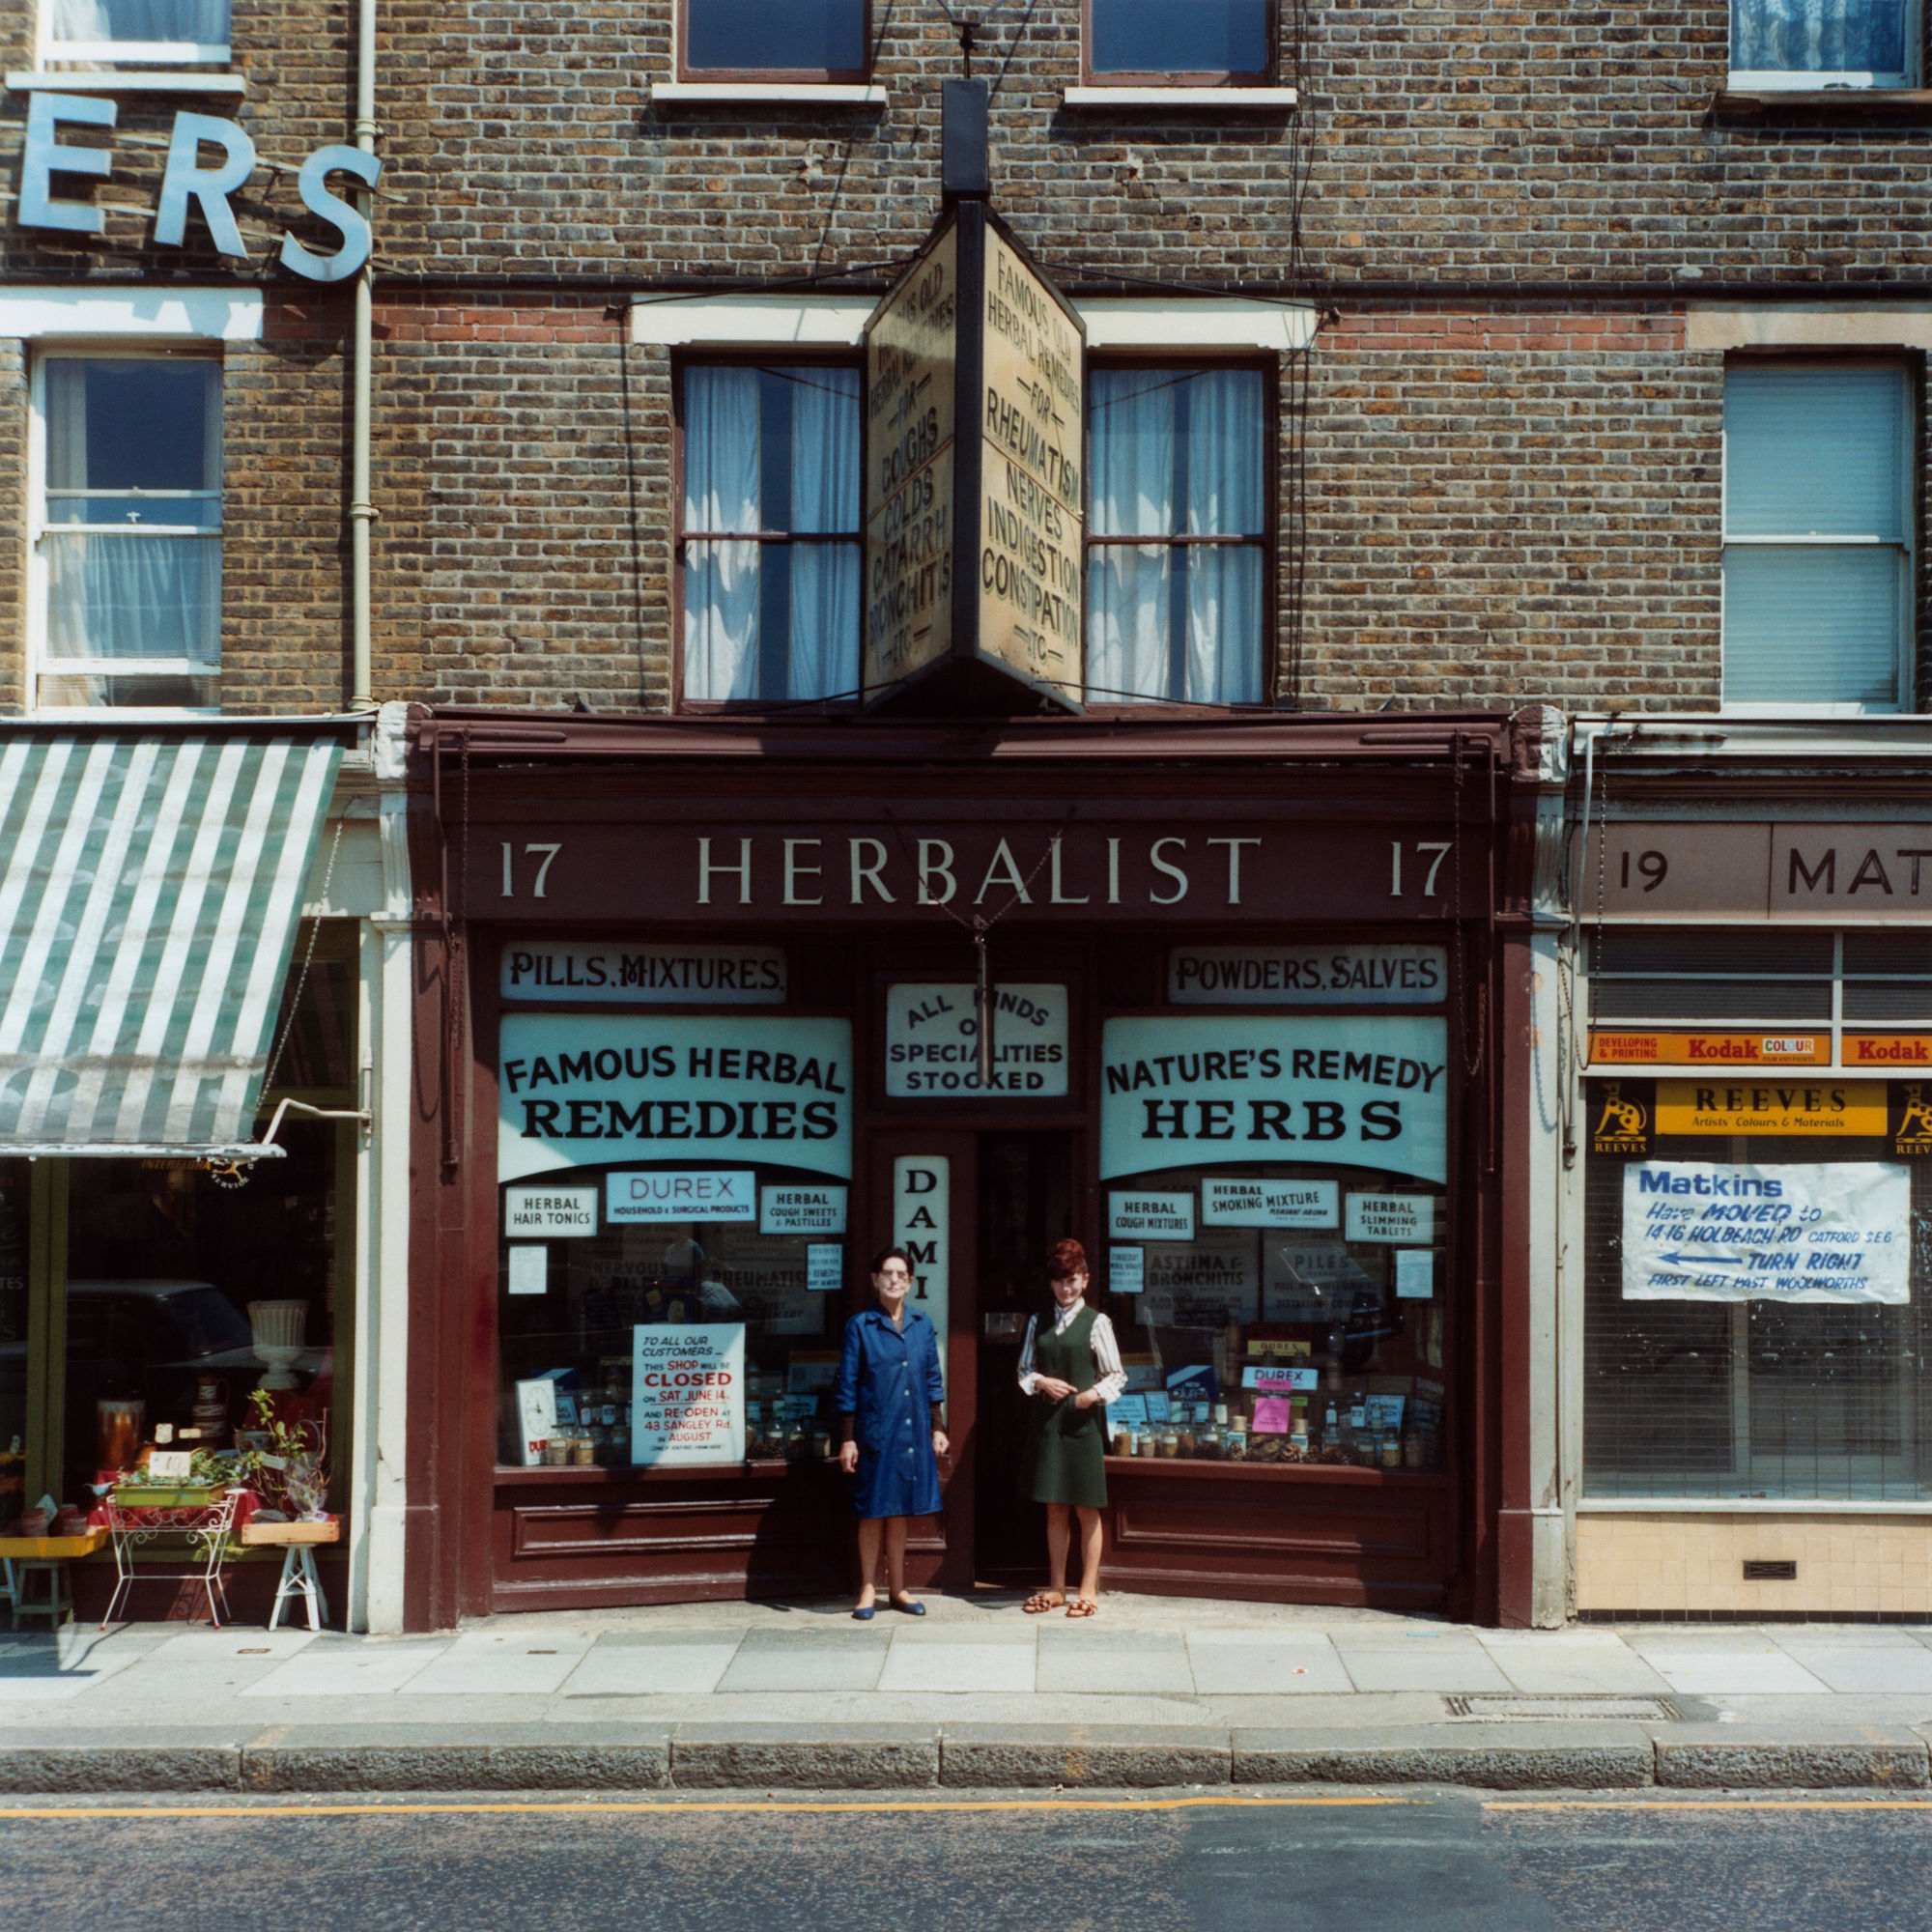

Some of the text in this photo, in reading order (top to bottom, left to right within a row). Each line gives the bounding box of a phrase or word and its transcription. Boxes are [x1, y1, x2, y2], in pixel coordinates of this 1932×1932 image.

[17, 91, 384, 282] ERS
[920, 262, 943, 312] OLD
[998, 249, 1071, 362] FAMOUS OLD
[988, 290, 1080, 415] HERBAL REMEDIES
[898, 380, 917, 417] FOR
[1030, 381, 1051, 423] FOR
[882, 406, 938, 493] COUGHS
[986, 385, 1080, 507] RHEUMATISM
[884, 466, 934, 541] COLDS
[1007, 460, 1063, 541] NERVES
[873, 504, 947, 595] CATARRH
[987, 496, 1079, 600] INDIGESTION
[868, 552, 951, 647] BRONCHITIS
[981, 547, 1079, 646] CONSTIPATION
[499, 836, 1455, 906] 17 HERBALIST 17
[1620, 850, 1668, 893] 19
[1788, 848, 1932, 895] MAT
[1330, 955, 1439, 990] SALVES
[907, 994, 954, 1030] ALL
[1599, 1037, 1658, 1047] DEVELOPING
[1688, 1038, 1813, 1059] Kodak COLOUR
[1858, 1039, 1929, 1060] Kodak
[1599, 1048, 1658, 1059] & PRINTING
[504, 1045, 846, 1094] FAMOUS HERBAL
[1105, 1048, 1446, 1094] NATURE'S REMEDY
[1695, 1088, 1846, 1112] REEVES
[521, 1099, 838, 1141] REMEDIES
[1141, 1099, 1403, 1142] HERBS
[1735, 1117, 1777, 1128] Colours
[1781, 1117, 1789, 1127] &
[1793, 1116, 1845, 1128] Materials
[1595, 1142, 1647, 1153] REEVES
[630, 1178, 734, 1200] DUREX
[1213, 1184, 1263, 1196] HERBAL
[1638, 1170, 1782, 1198] Matkins
[524, 1198, 581, 1210] HERBAL
[777, 1193, 829, 1206] HERBAL
[1123, 1202, 1177, 1214] HERBAL
[1211, 1191, 1321, 1213] SMOKING MIXTURE
[1362, 1201, 1415, 1214] HERBAL
[513, 1211, 591, 1226] HAIR TONICS
[613, 1206, 663, 1214] HOUSEHOLD
[671, 1206, 709, 1214] SURGICAL
[710, 1205, 750, 1213] PRODUCTS
[769, 1208, 837, 1218] COUGH SWEETS
[1646, 1202, 1822, 1223] Have MOVED to
[784, 1216, 832, 1227] PASTILLES
[1115, 1216, 1188, 1230] COUGH MIXTURES
[1360, 1215, 1418, 1227] SLIMMING
[1366, 1225, 1412, 1237] TABLETS
[1688, 1225, 1775, 1244] HOLBEACH
[1777, 1226, 1803, 1244] RD
[1807, 1232, 1861, 1244] CATFORD
[593, 1261, 669, 1275] NERVOUS
[1151, 1255, 1225, 1270] ASTHMA
[1293, 1254, 1350, 1269] PILES
[1747, 1252, 1864, 1271] TURN RIGHT
[712, 1269, 805, 1288] RHEUMATIS
[1150, 1271, 1244, 1286] BRONCHITIS
[1648, 1274, 1693, 1287] FIRST
[1696, 1274, 1730, 1287] LEFT
[1776, 1276, 1869, 1291] WOOLWORTHS
[643, 1336, 708, 1346] TO ALL OUR
[641, 1347, 714, 1357] CUSTOMERS
[667, 1359, 698, 1371] SHOP
[643, 1372, 732, 1387] CLOSED
[1254, 1369, 1304, 1381] DUREX
[684, 1389, 713, 1403] JUNE
[664, 1407, 719, 1418] RE-OPEN
[644, 1420, 661, 1432] 43
[663, 1419, 712, 1431] SANGLEY
[668, 1432, 712, 1442] AUGUST
